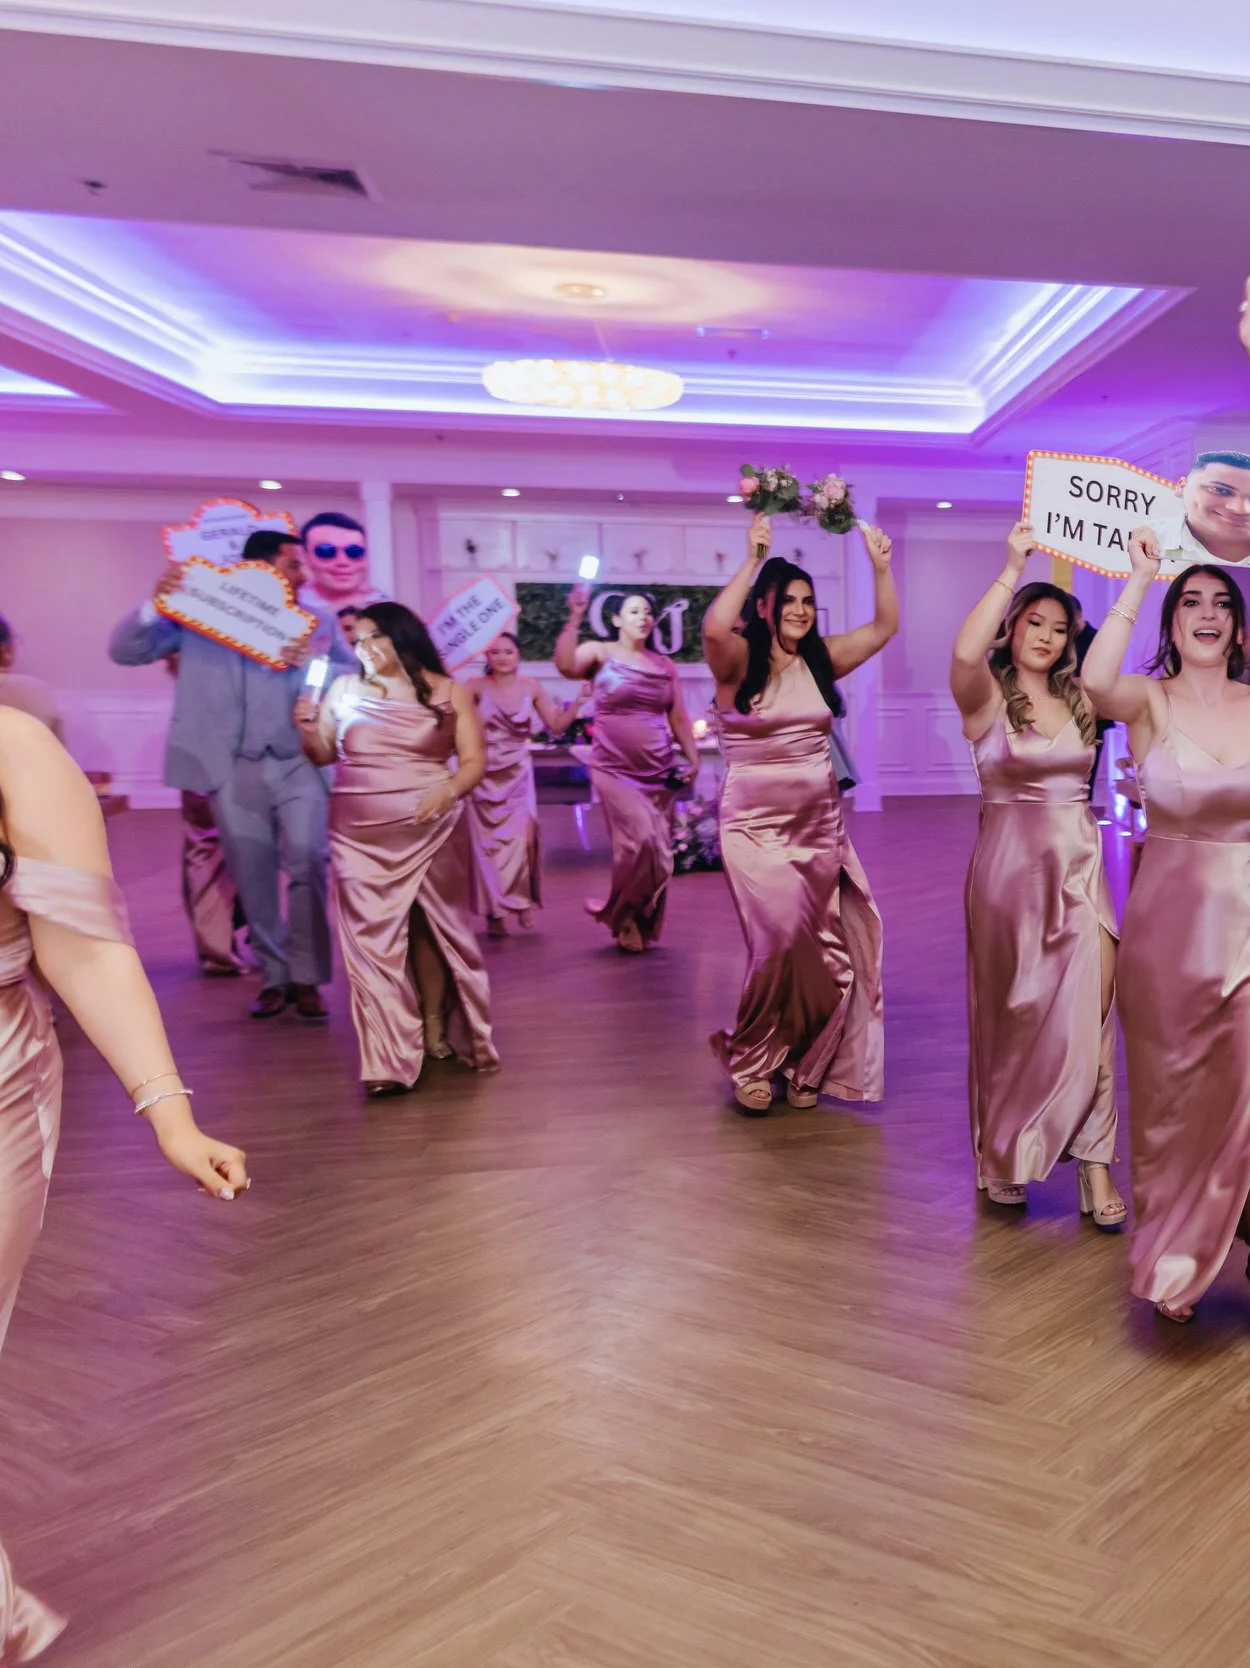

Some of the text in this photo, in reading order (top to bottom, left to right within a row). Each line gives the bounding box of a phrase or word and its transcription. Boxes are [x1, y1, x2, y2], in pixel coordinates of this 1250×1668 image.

[1068, 475, 1156, 516] SORRY
[1092, 522, 1133, 552] TA
[189, 587, 286, 641] SUBSCRIPTION
[219, 580, 281, 618] LIFETIME
[455, 594, 482, 618] THE
[478, 598, 504, 624] ONE
